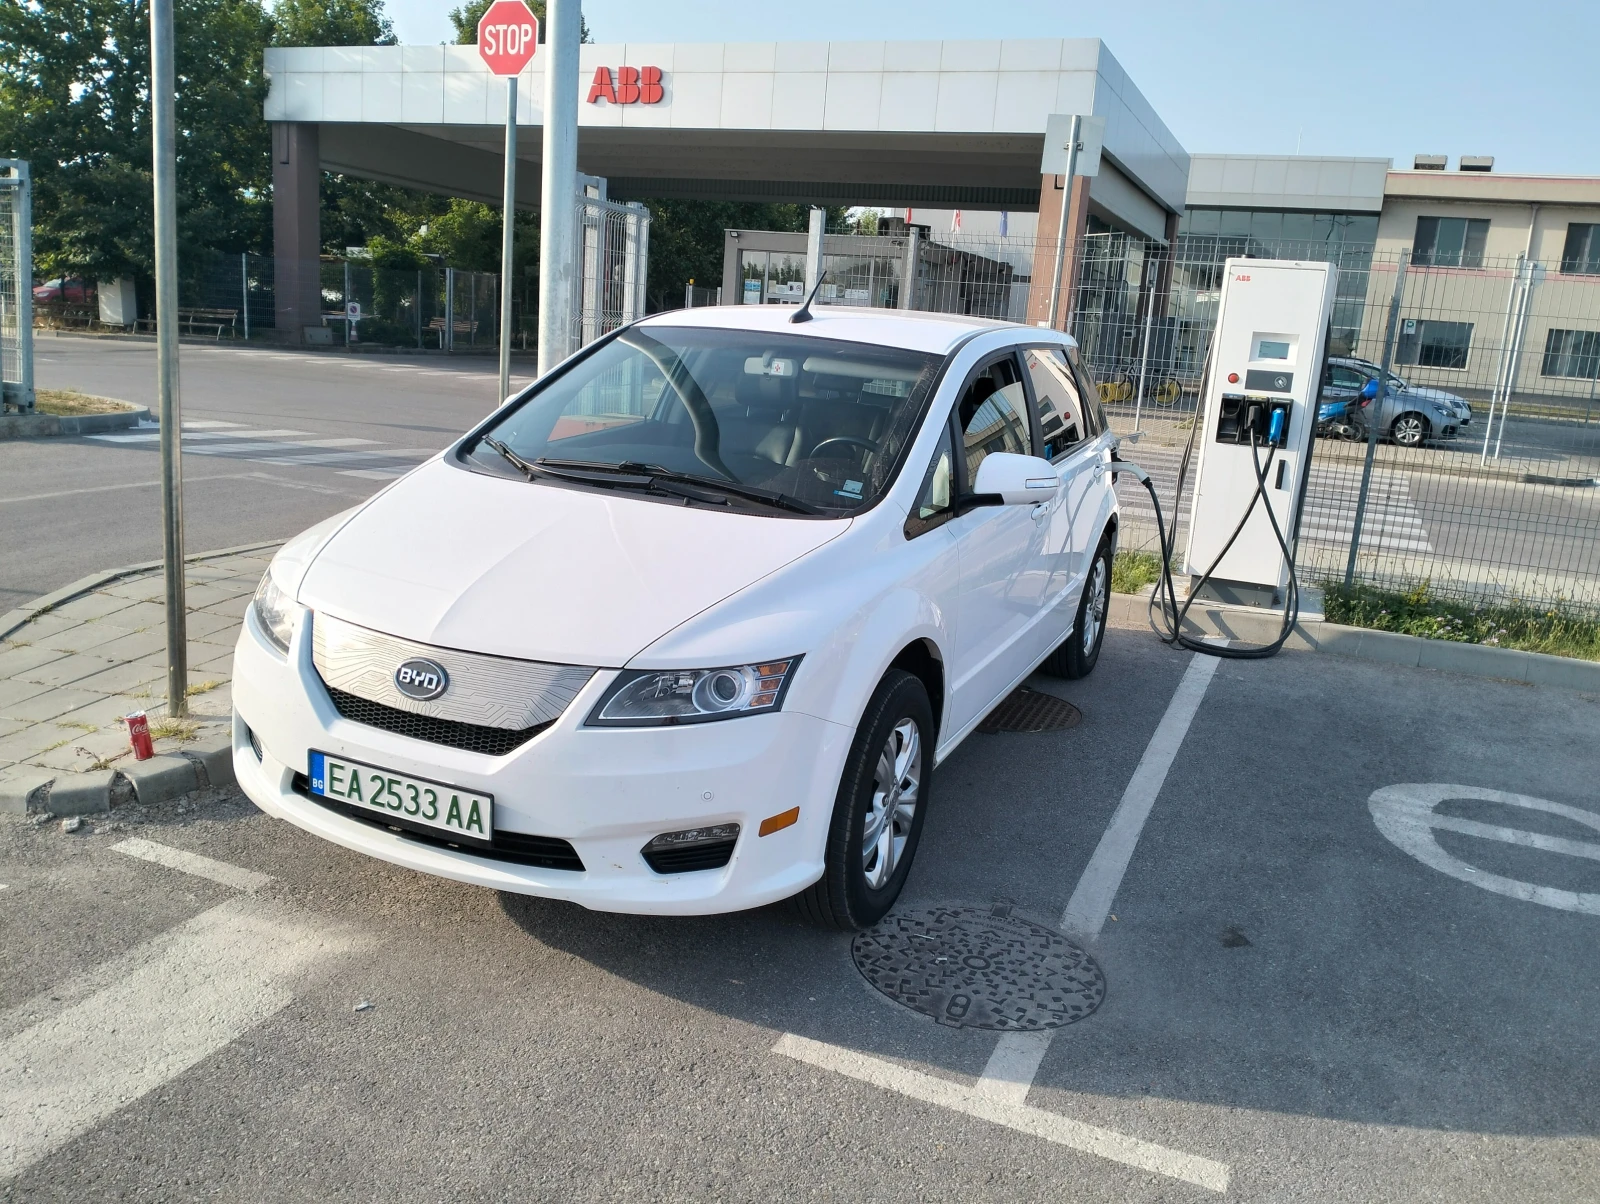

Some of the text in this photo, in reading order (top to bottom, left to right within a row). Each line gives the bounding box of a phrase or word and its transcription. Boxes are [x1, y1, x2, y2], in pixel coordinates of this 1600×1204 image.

[484, 24, 532, 55] STOP
[587, 66, 664, 104] ABB
[400, 667, 438, 690] BYD
[312, 778, 323, 789] BG
[329, 763, 484, 834] EA 2533 AA
